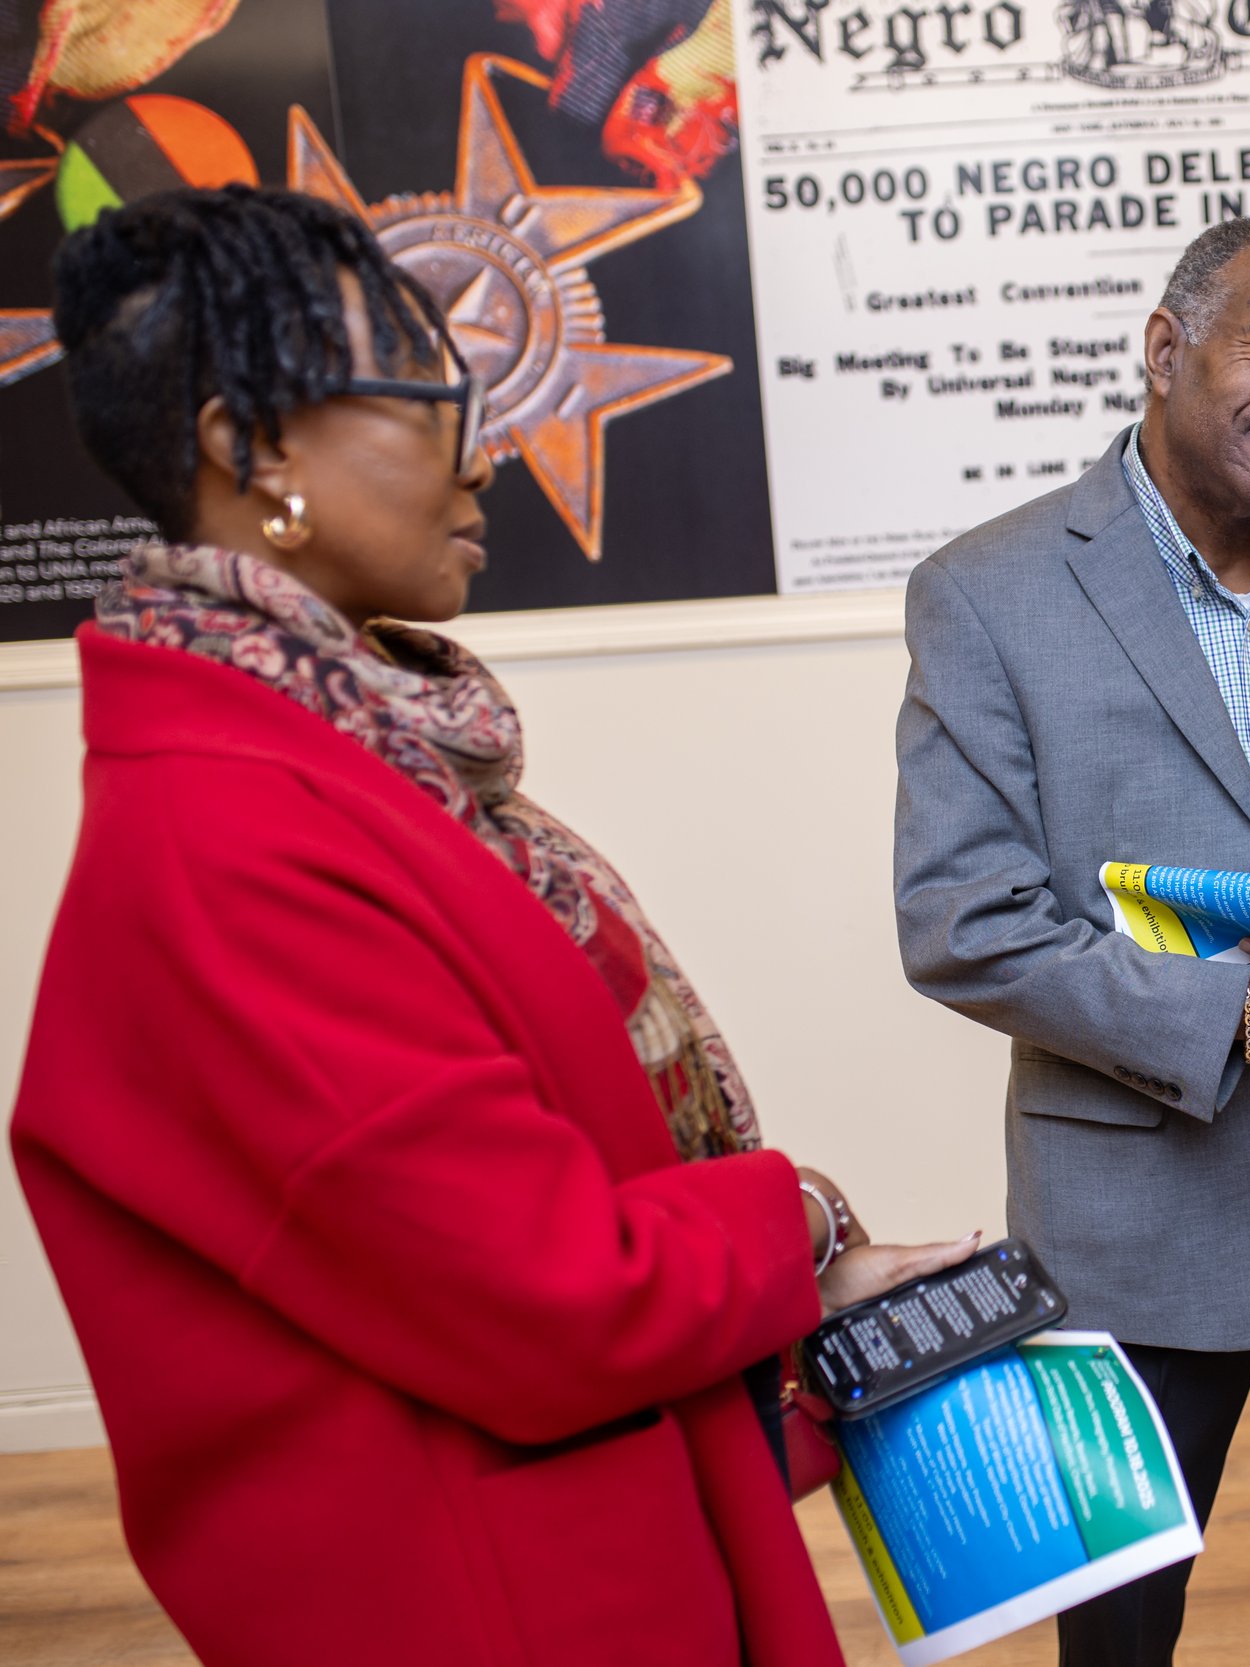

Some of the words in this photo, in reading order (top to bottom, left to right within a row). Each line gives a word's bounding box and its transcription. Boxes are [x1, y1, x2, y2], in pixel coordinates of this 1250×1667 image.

[765, 166, 928, 213] 50,000
[957, 154, 1117, 196] NEGRO
[901, 207, 961, 243] TO
[987, 195, 1178, 237] PARADE
[1202, 191, 1244, 224] IN
[866, 287, 977, 312] Greatest
[1001, 276, 1142, 301] Convention
[777, 356, 815, 379] Big
[836, 348, 931, 374] Meeting
[950, 344, 981, 364] To
[999, 340, 1029, 361] Be
[1047, 336, 1129, 359] Staged
[880, 379, 911, 400] By
[928, 370, 1033, 395] Universal
[1052, 367, 1120, 388] Negro
[995, 398, 1085, 421] Monday
[1149, 874, 1157, 888] and
[1189, 884, 1197, 899] and
[1223, 899, 1233, 912] and
[1237, 882, 1250, 919] Foundation
[1099, 1378, 1133, 1438] PROGRAM
[1117, 1436, 1160, 1511] 10.18.2025
